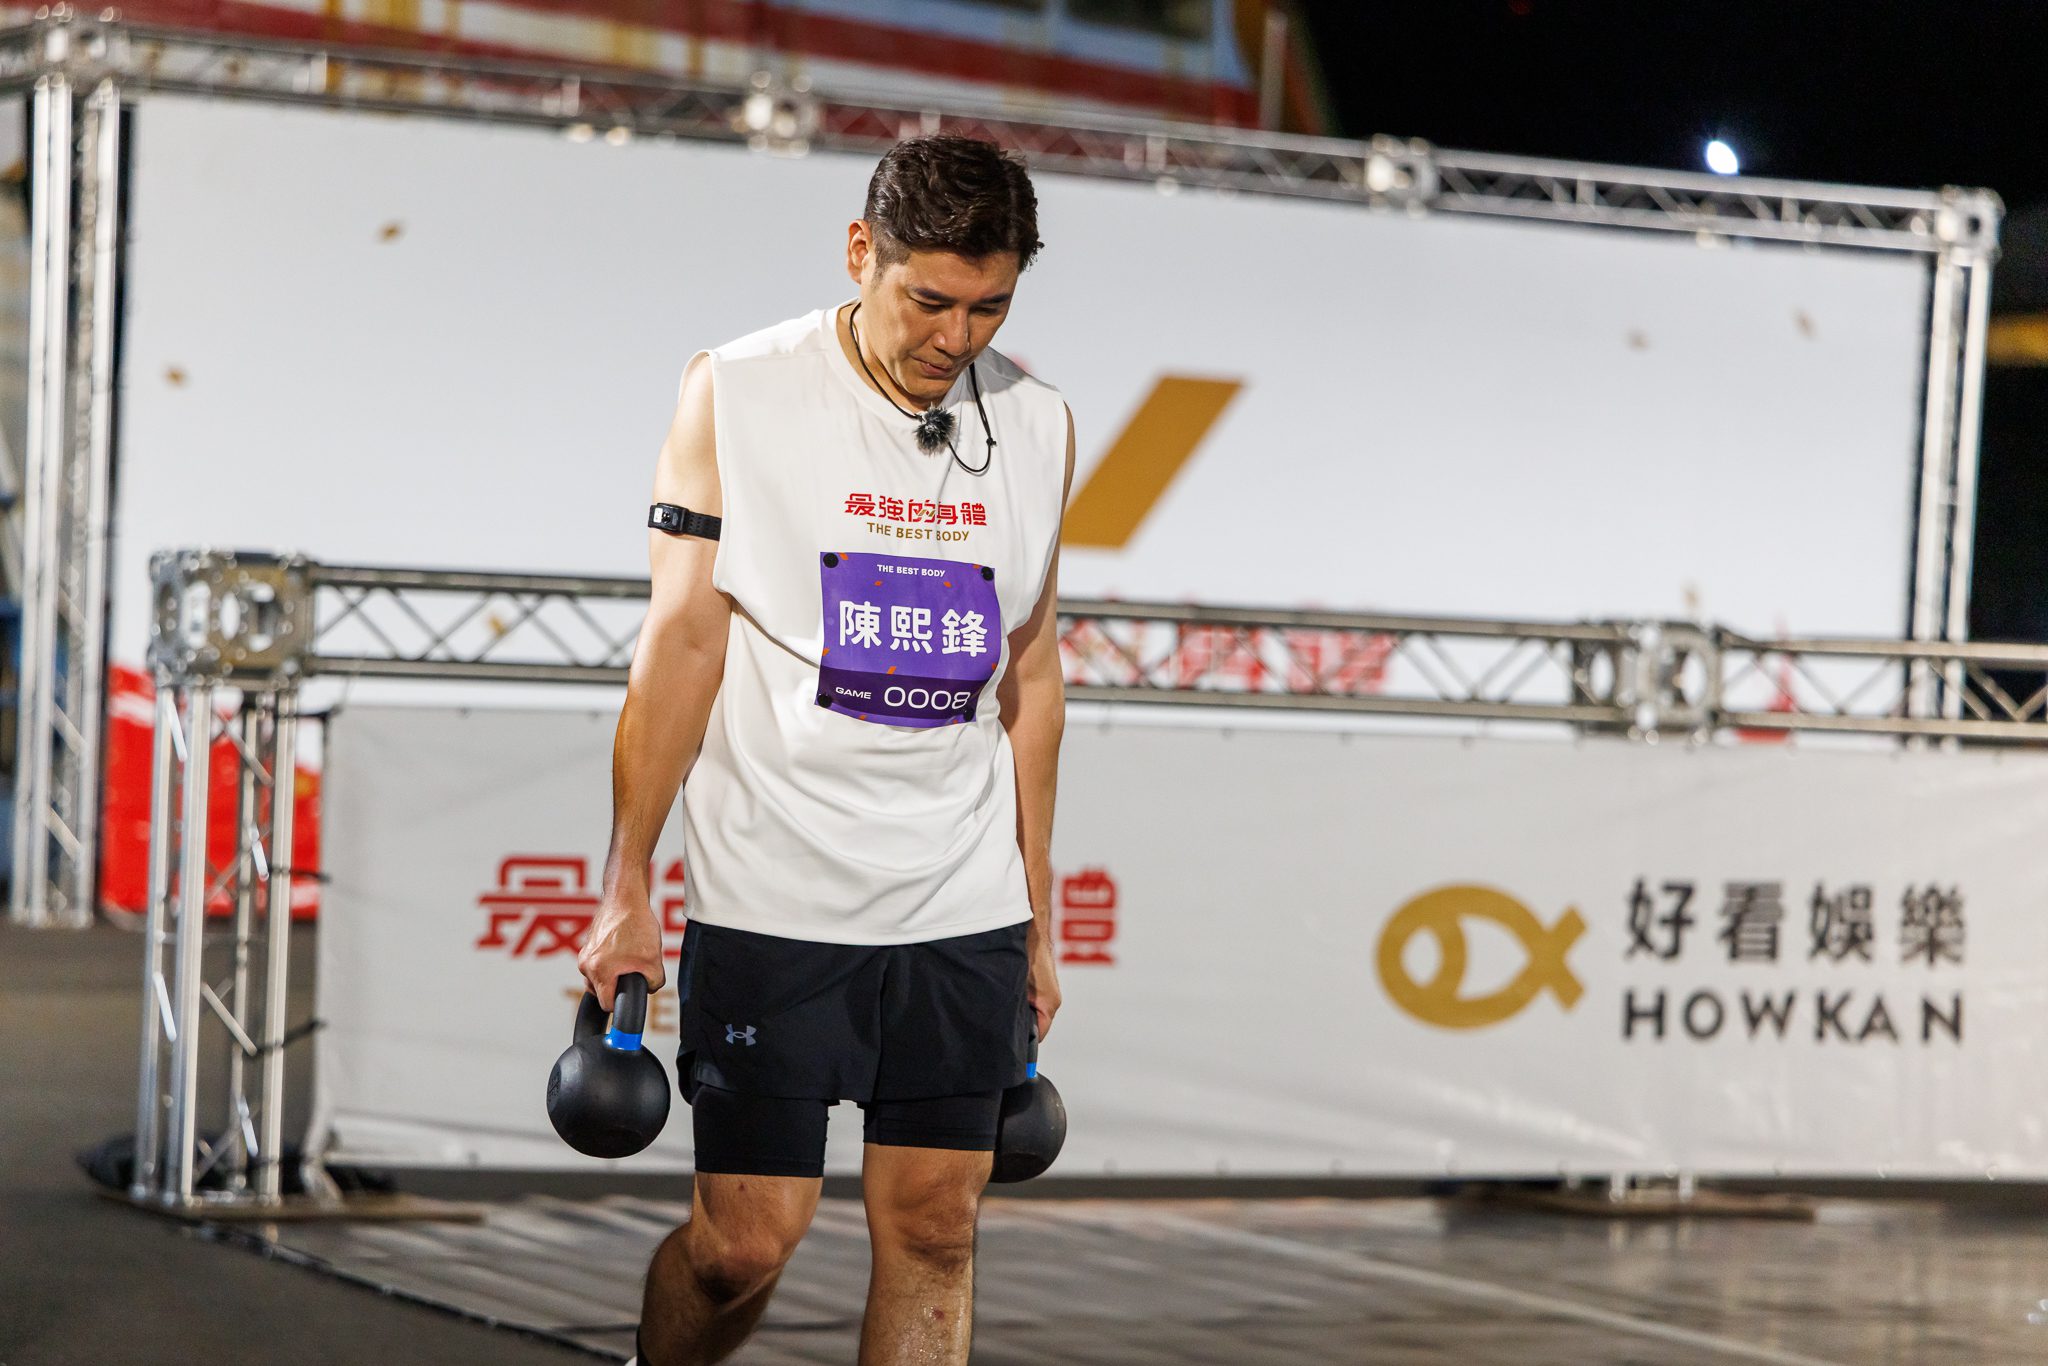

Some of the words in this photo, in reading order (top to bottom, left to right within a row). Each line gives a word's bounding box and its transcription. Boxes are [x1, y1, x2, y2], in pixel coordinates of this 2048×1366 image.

[844, 493, 987, 526] 最強的身體
[867, 522, 892, 536] THE
[896, 527, 933, 540] BEST
[936, 530, 970, 542] BODY
[877, 564, 894, 574] THE
[896, 566, 919, 577] BEST
[921, 568, 946, 578] BODY
[839, 600, 988, 658] 陳熙鋒
[835, 686, 872, 700] GAME
[884, 686, 971, 711] 0008
[1625, 877, 1965, 965] 好看娛樂
[1623, 988, 1964, 1041] HOWKAN
